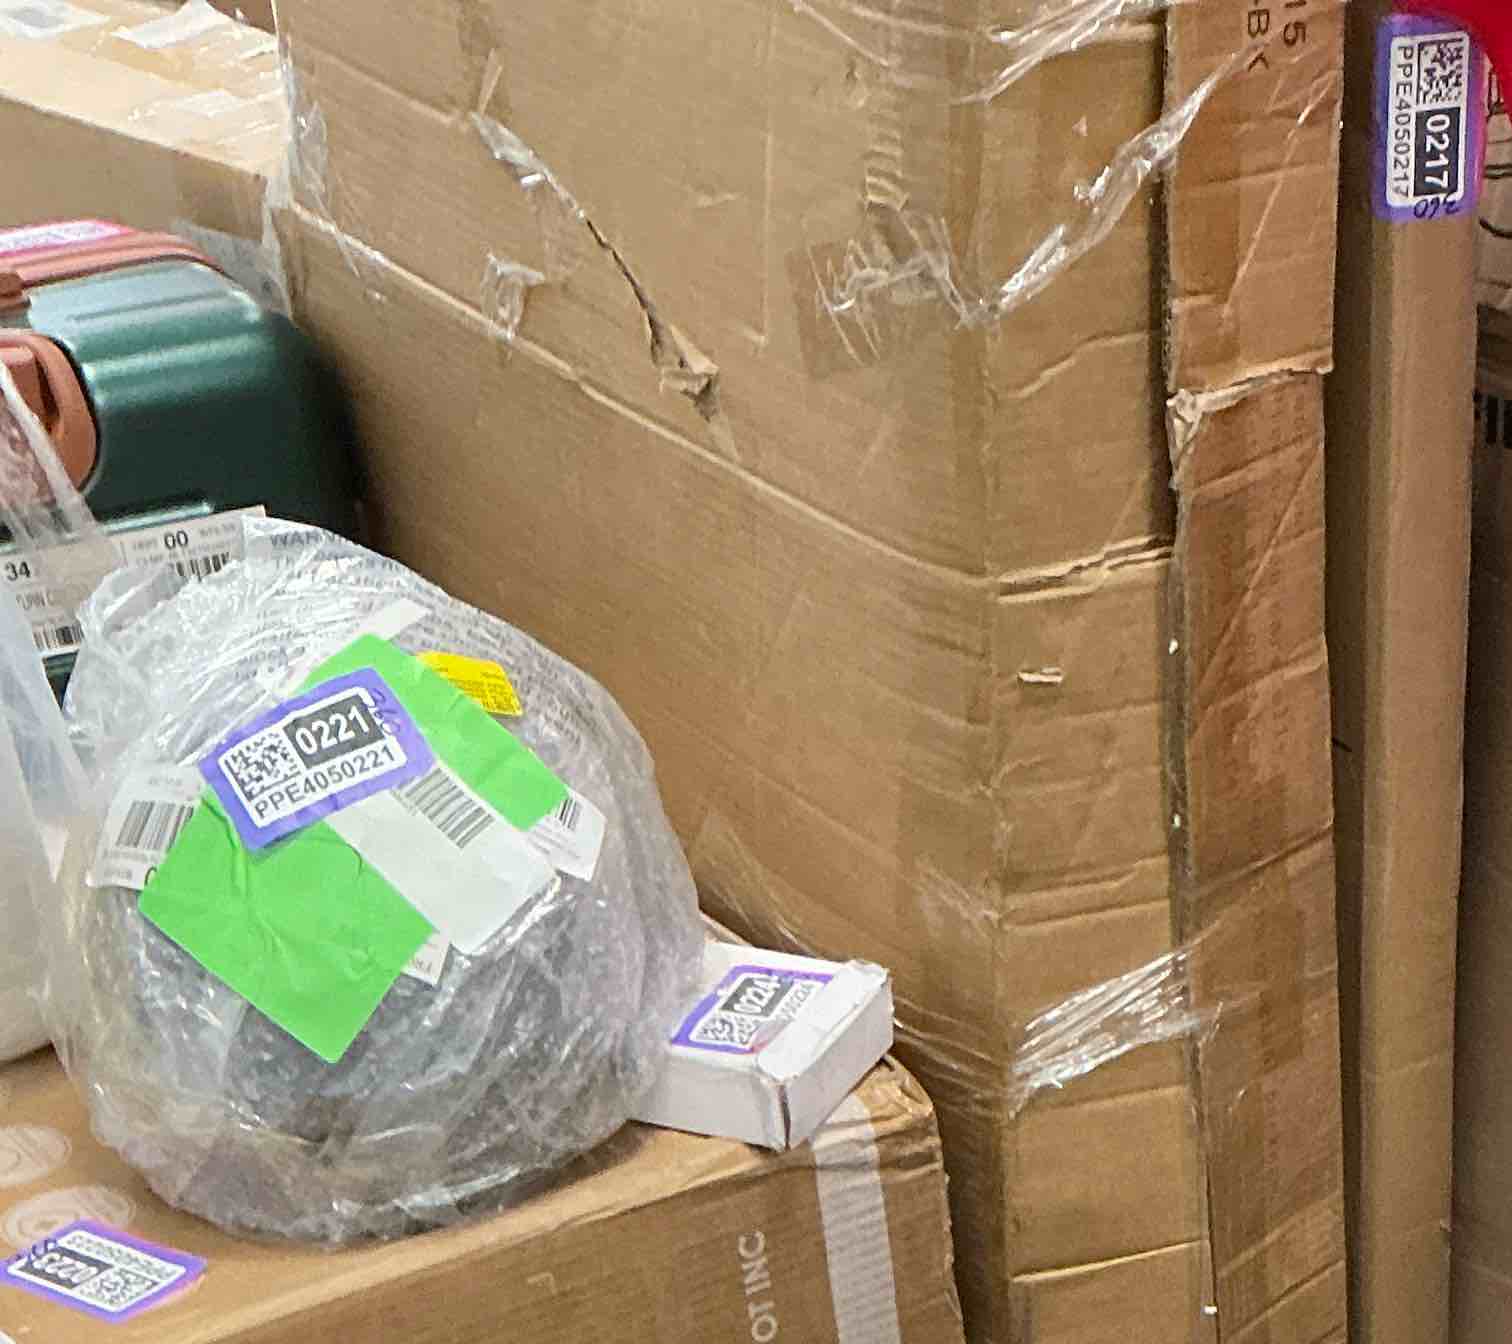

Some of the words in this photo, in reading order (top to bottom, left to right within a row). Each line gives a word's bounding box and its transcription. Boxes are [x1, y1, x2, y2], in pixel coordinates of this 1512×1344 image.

[1392, 45, 1414, 198] PPE4050217
[1424, 113, 1450, 194] 0217
[163, 530, 190, 551] 00
[294, 704, 372, 757] 0221
[253, 743, 397, 820] PPE4050221
[31, 1250, 101, 1286] 0223
[738, 1228, 772, 1298] INC
